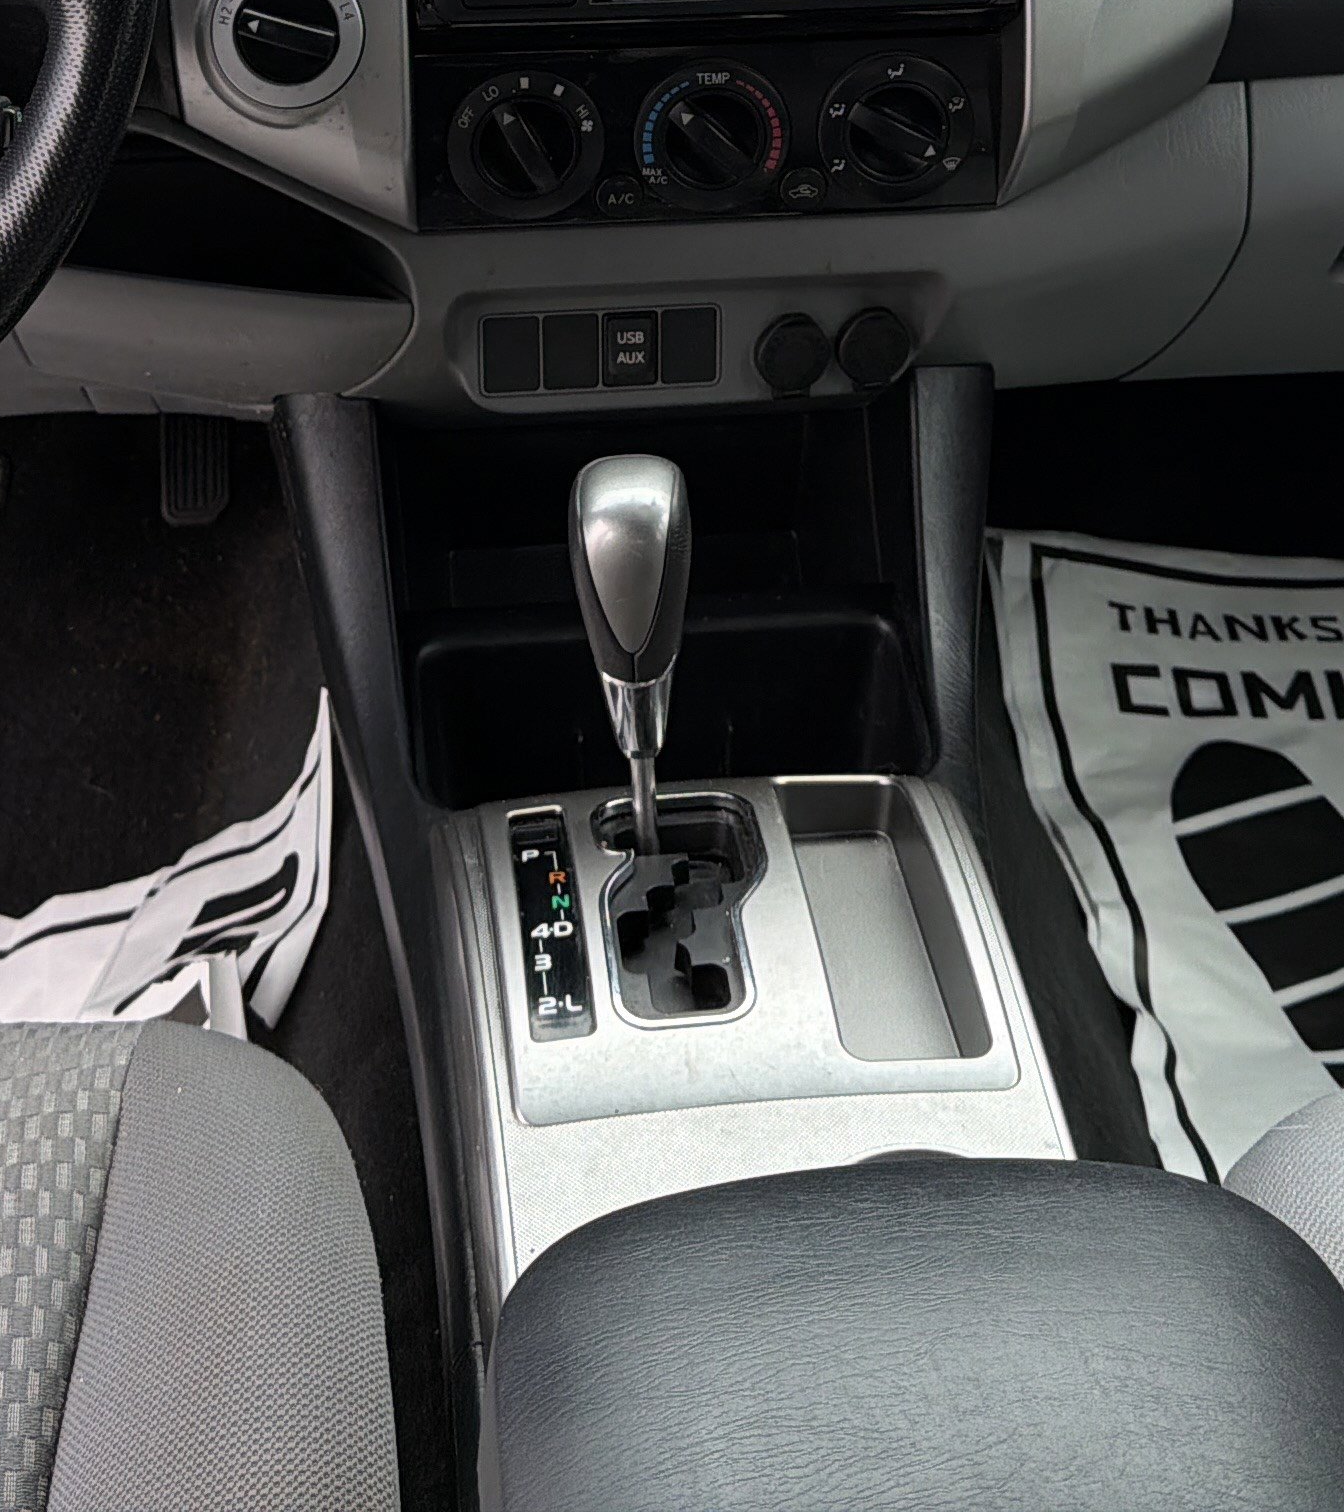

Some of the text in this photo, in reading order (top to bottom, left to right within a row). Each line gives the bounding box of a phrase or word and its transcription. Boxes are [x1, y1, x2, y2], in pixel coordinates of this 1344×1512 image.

[696, 72, 731, 85] TEMP
[482, 86, 499, 102] LO
[457, 106, 474, 129] OFF
[576, 104, 590, 120] HI
[642, 168, 662, 176] MAX
[649, 176, 668, 185] A/C
[607, 192, 635, 205] A/C
[616, 331, 645, 345] USB
[616, 350, 645, 364] AUX
[1108, 599, 1344, 643] THANKS
[521, 849, 540, 863] P
[548, 871, 567, 885] R
[551, 893, 570, 910] N
[534, 953, 553, 972] 3
